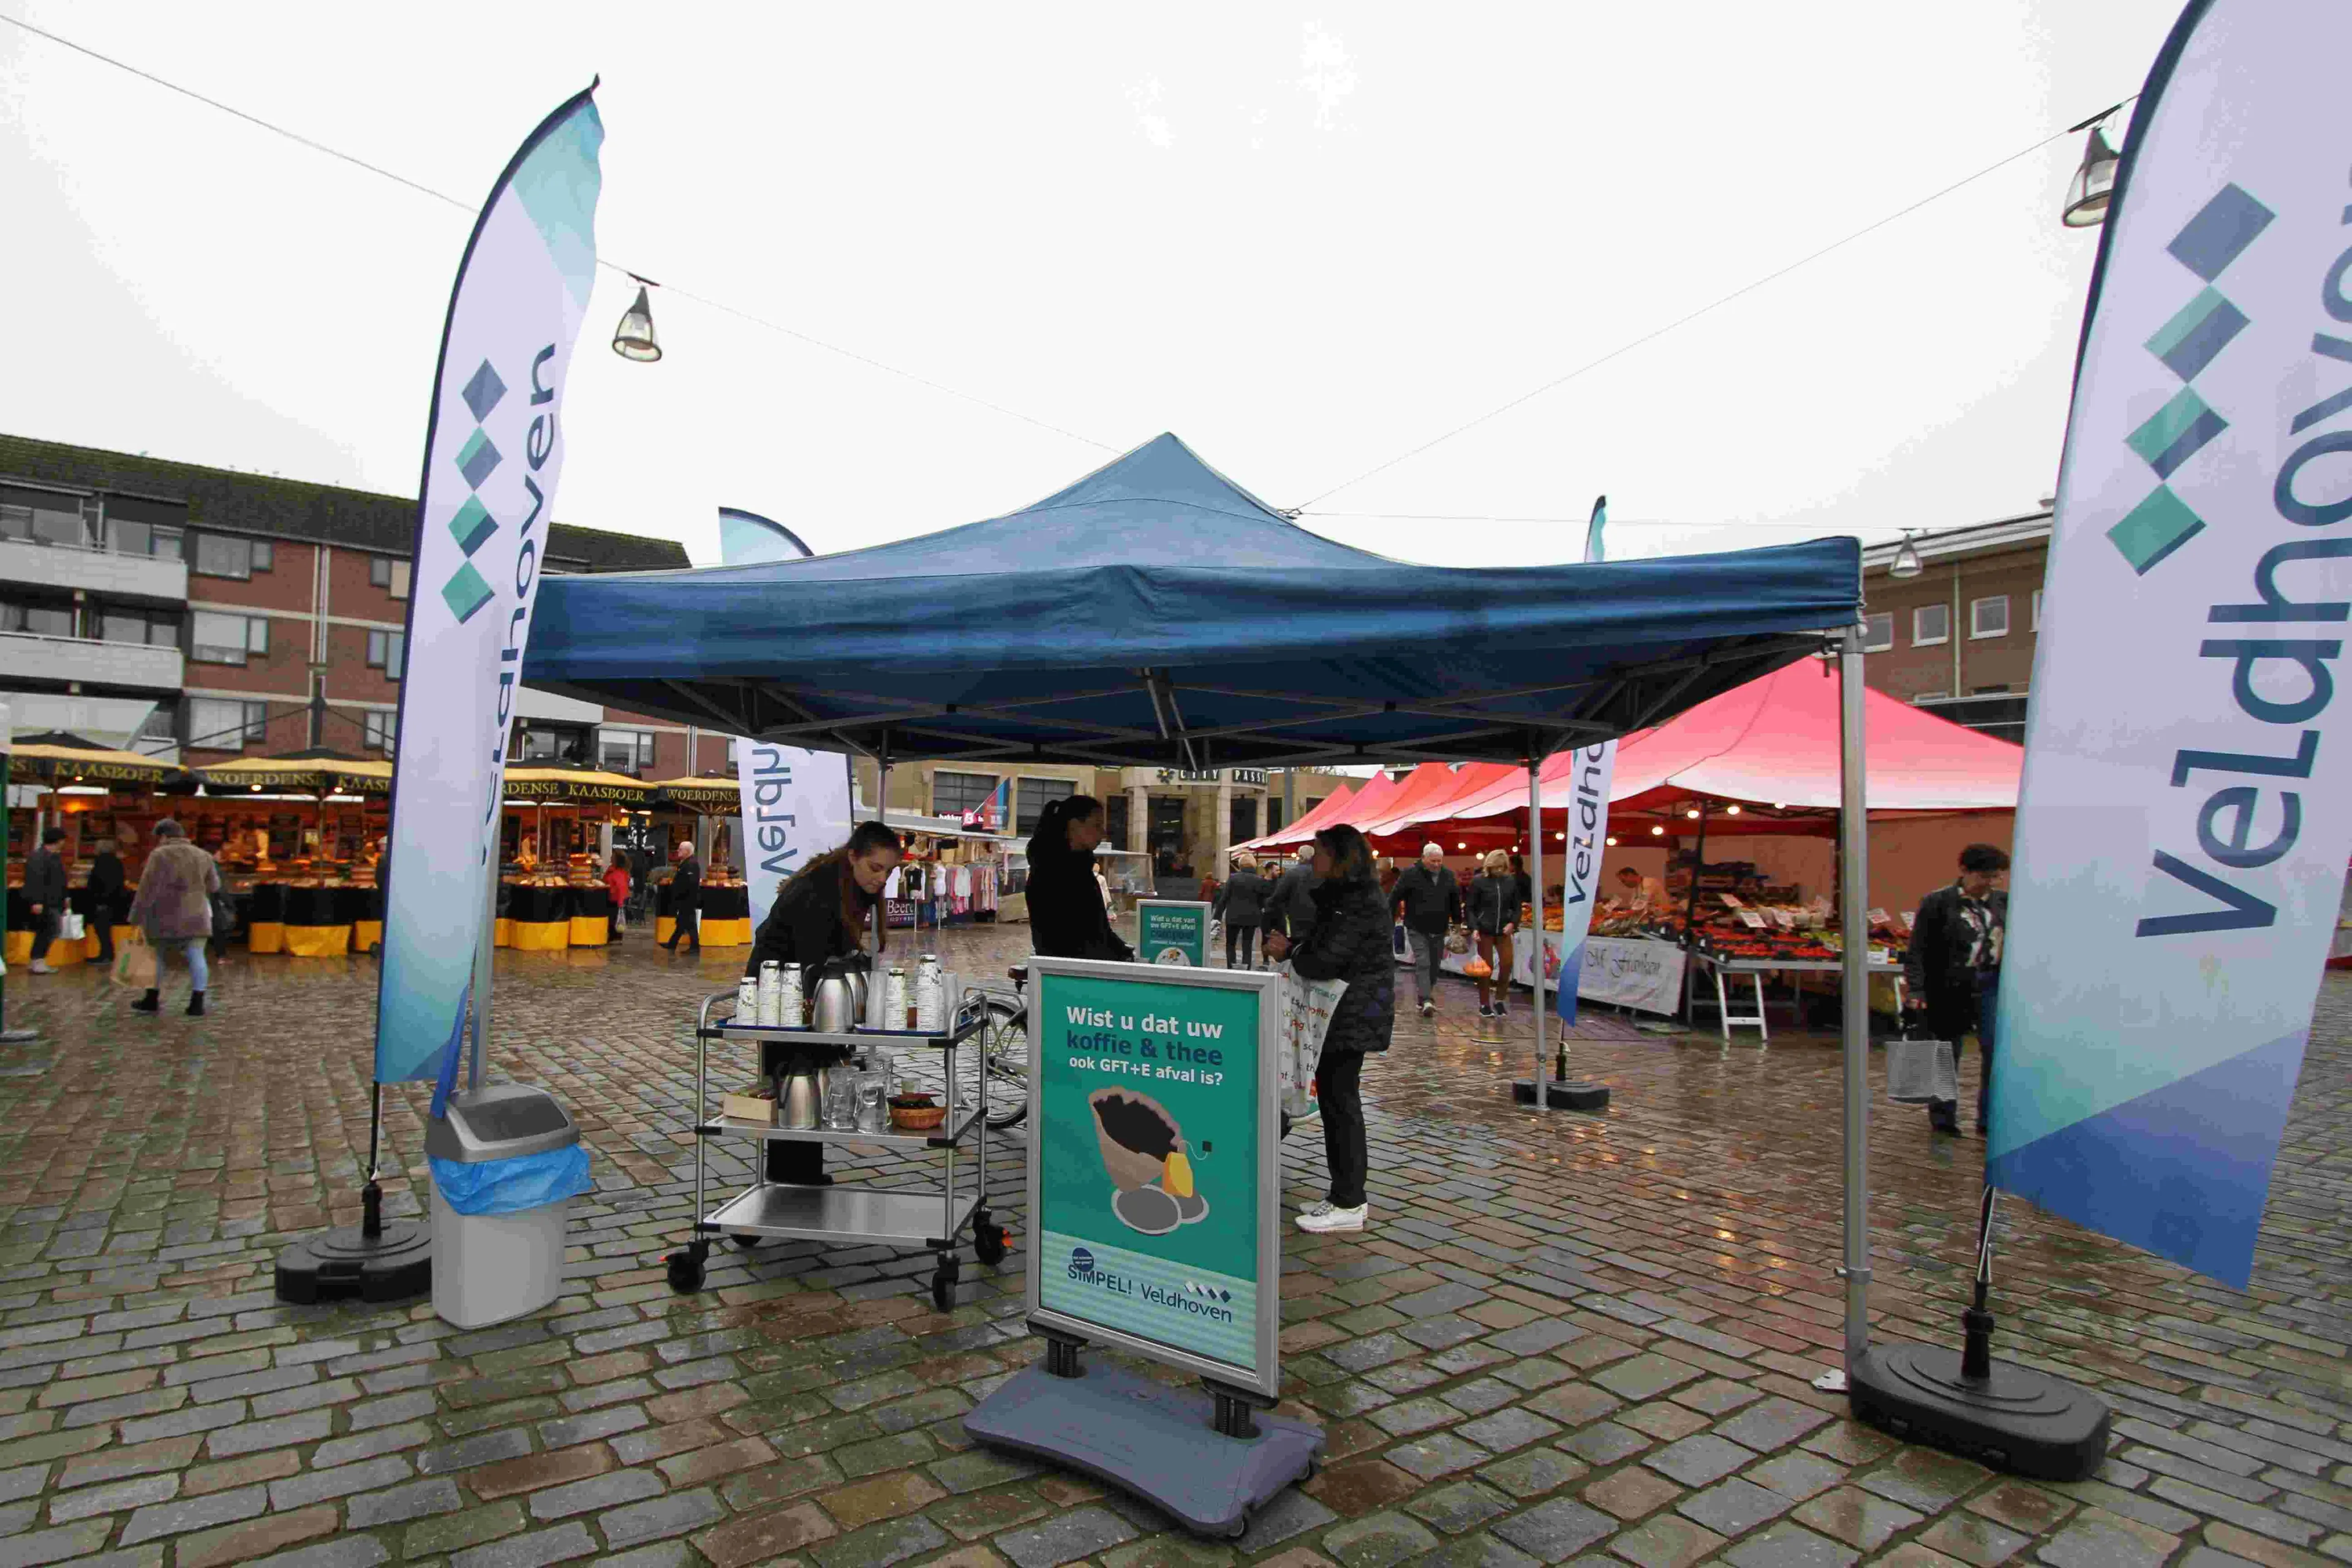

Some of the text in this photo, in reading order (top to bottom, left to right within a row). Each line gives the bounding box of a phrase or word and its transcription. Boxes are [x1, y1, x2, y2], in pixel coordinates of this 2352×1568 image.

[2135, 163, 2352, 938] Veldhov
[481, 342, 556, 867] ldhoven
[55, 761, 164, 783] KAASBOER
[569, 784, 644, 802] KAASBOER
[1066, 1006, 1223, 1039] Wist u dat uw
[1066, 1030, 1223, 1065] koffie & thee
[1069, 1057, 1223, 1086] ook GFT+E afval is?
[1140, 1283, 1232, 1323] Veldhoven
